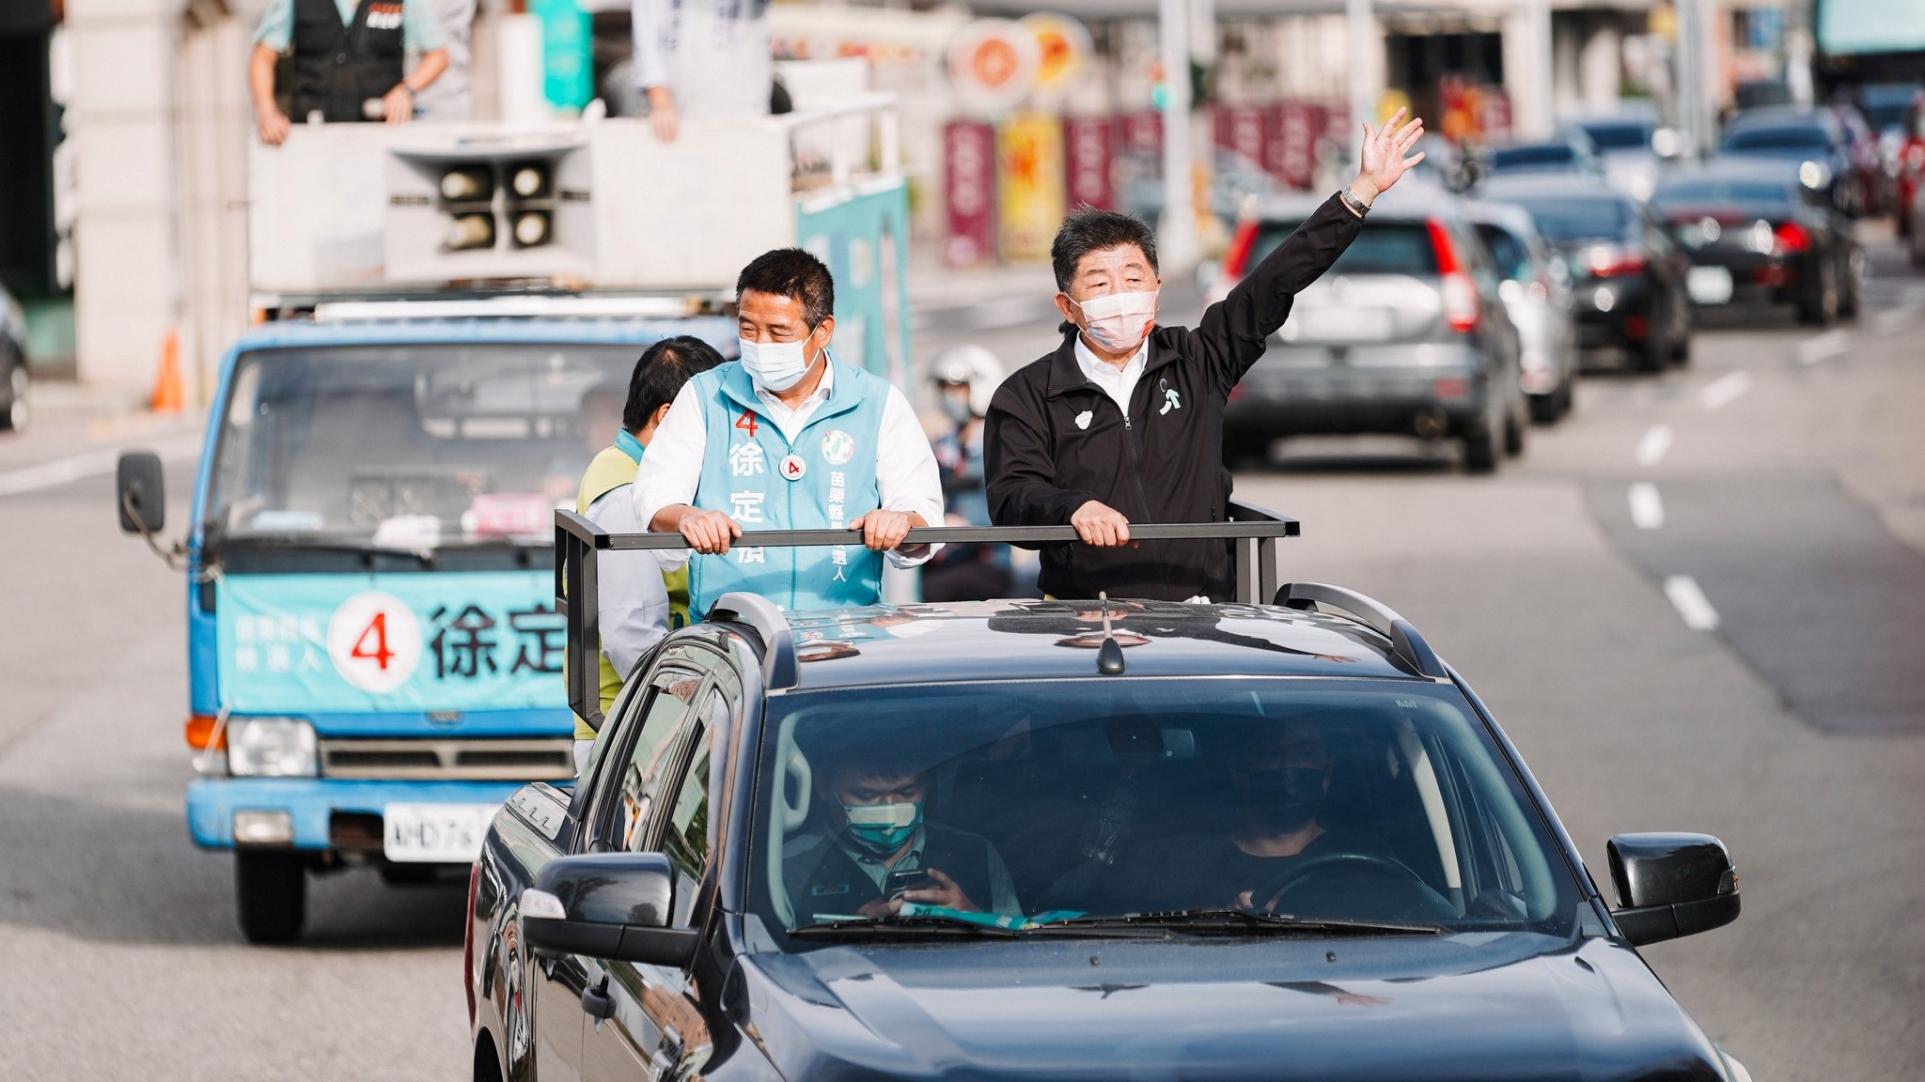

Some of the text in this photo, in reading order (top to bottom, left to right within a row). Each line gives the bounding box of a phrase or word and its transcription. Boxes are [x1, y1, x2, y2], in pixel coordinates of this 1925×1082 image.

[735, 409, 759, 438] 4
[788, 461, 800, 475] 4
[351, 611, 396, 671] 4
